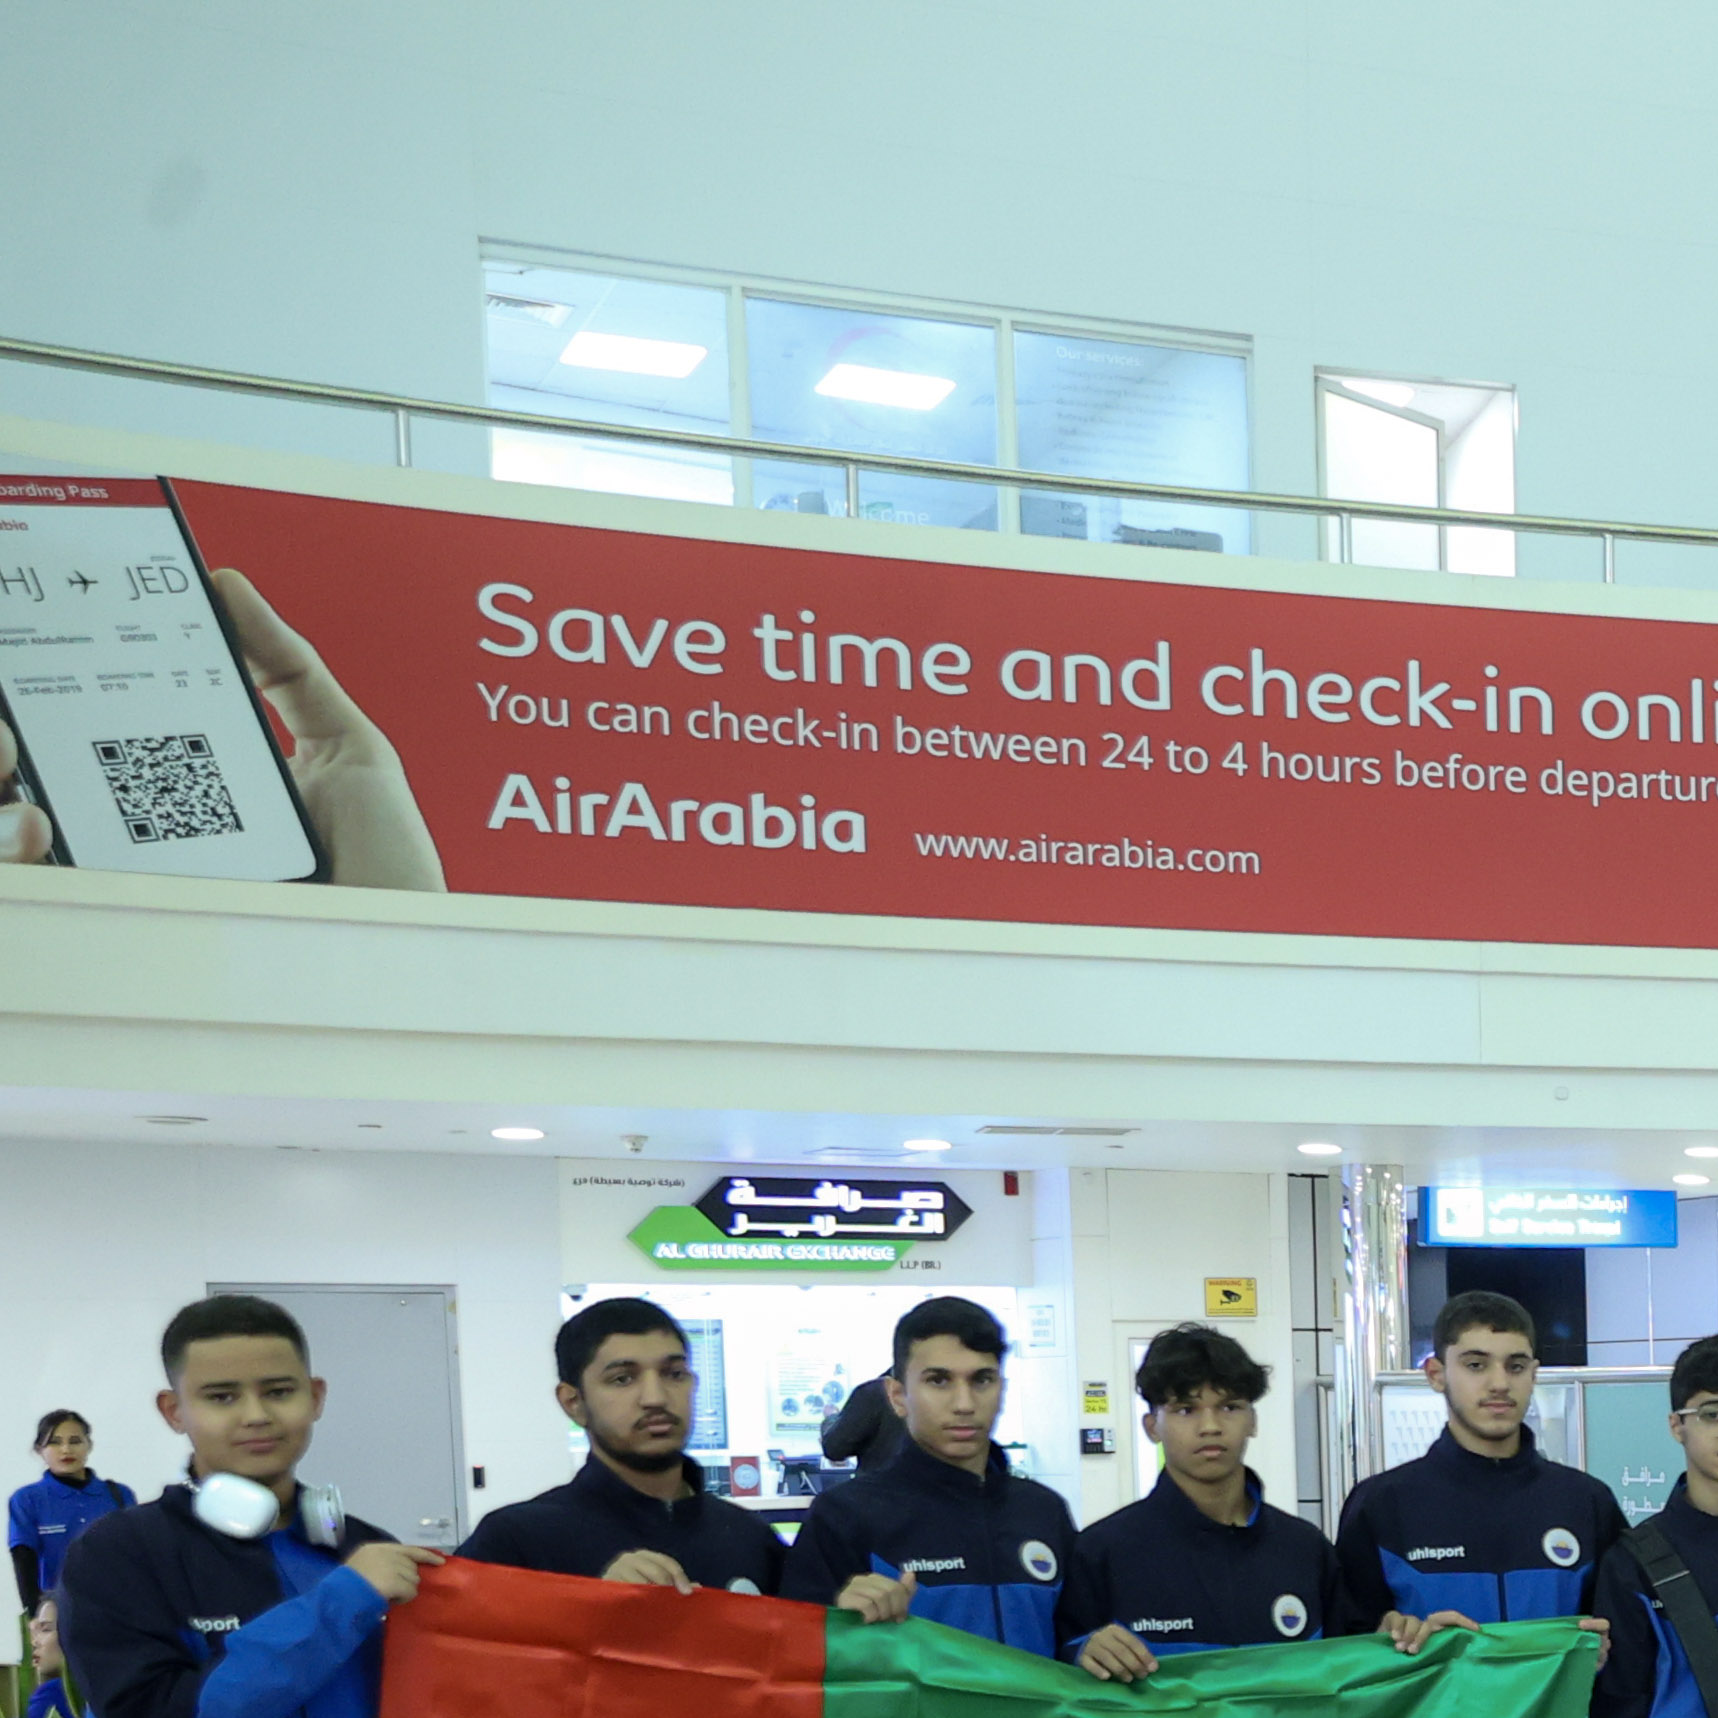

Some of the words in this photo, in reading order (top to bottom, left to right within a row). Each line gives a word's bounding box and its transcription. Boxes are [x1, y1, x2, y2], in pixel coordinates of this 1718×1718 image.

[0, 484, 66, 501] oarding
[67, 485, 109, 499] Pass
[0, 566, 45, 602] HJ
[126, 566, 189, 601] JED
[476, 581, 727, 676] Save
[753, 608, 972, 699] time
[1001, 640, 1172, 712] and
[1201, 647, 1555, 735] check-in
[477, 681, 570, 729] You
[586, 698, 670, 736] can
[686, 696, 878, 752] check-in
[893, 712, 1087, 767] between
[1100, 732, 1154, 772] 24
[1166, 740, 1208, 775] to
[1221, 737, 1248, 776] 4
[1260, 742, 1382, 787] hours
[1395, 750, 1527, 793] before
[487, 772, 866, 854] AirArabia
[915, 829, 1260, 875] www.airarabia.com
[654, 1243, 686, 1260] AL
[687, 1244, 784, 1261] GHURAIR
[787, 1245, 896, 1262] EXCHANGE
[1407, 1546, 1465, 1561] uhlsport
[903, 1557, 966, 1573] uhlsport
[1132, 1618, 1194, 1634] uhlsport
